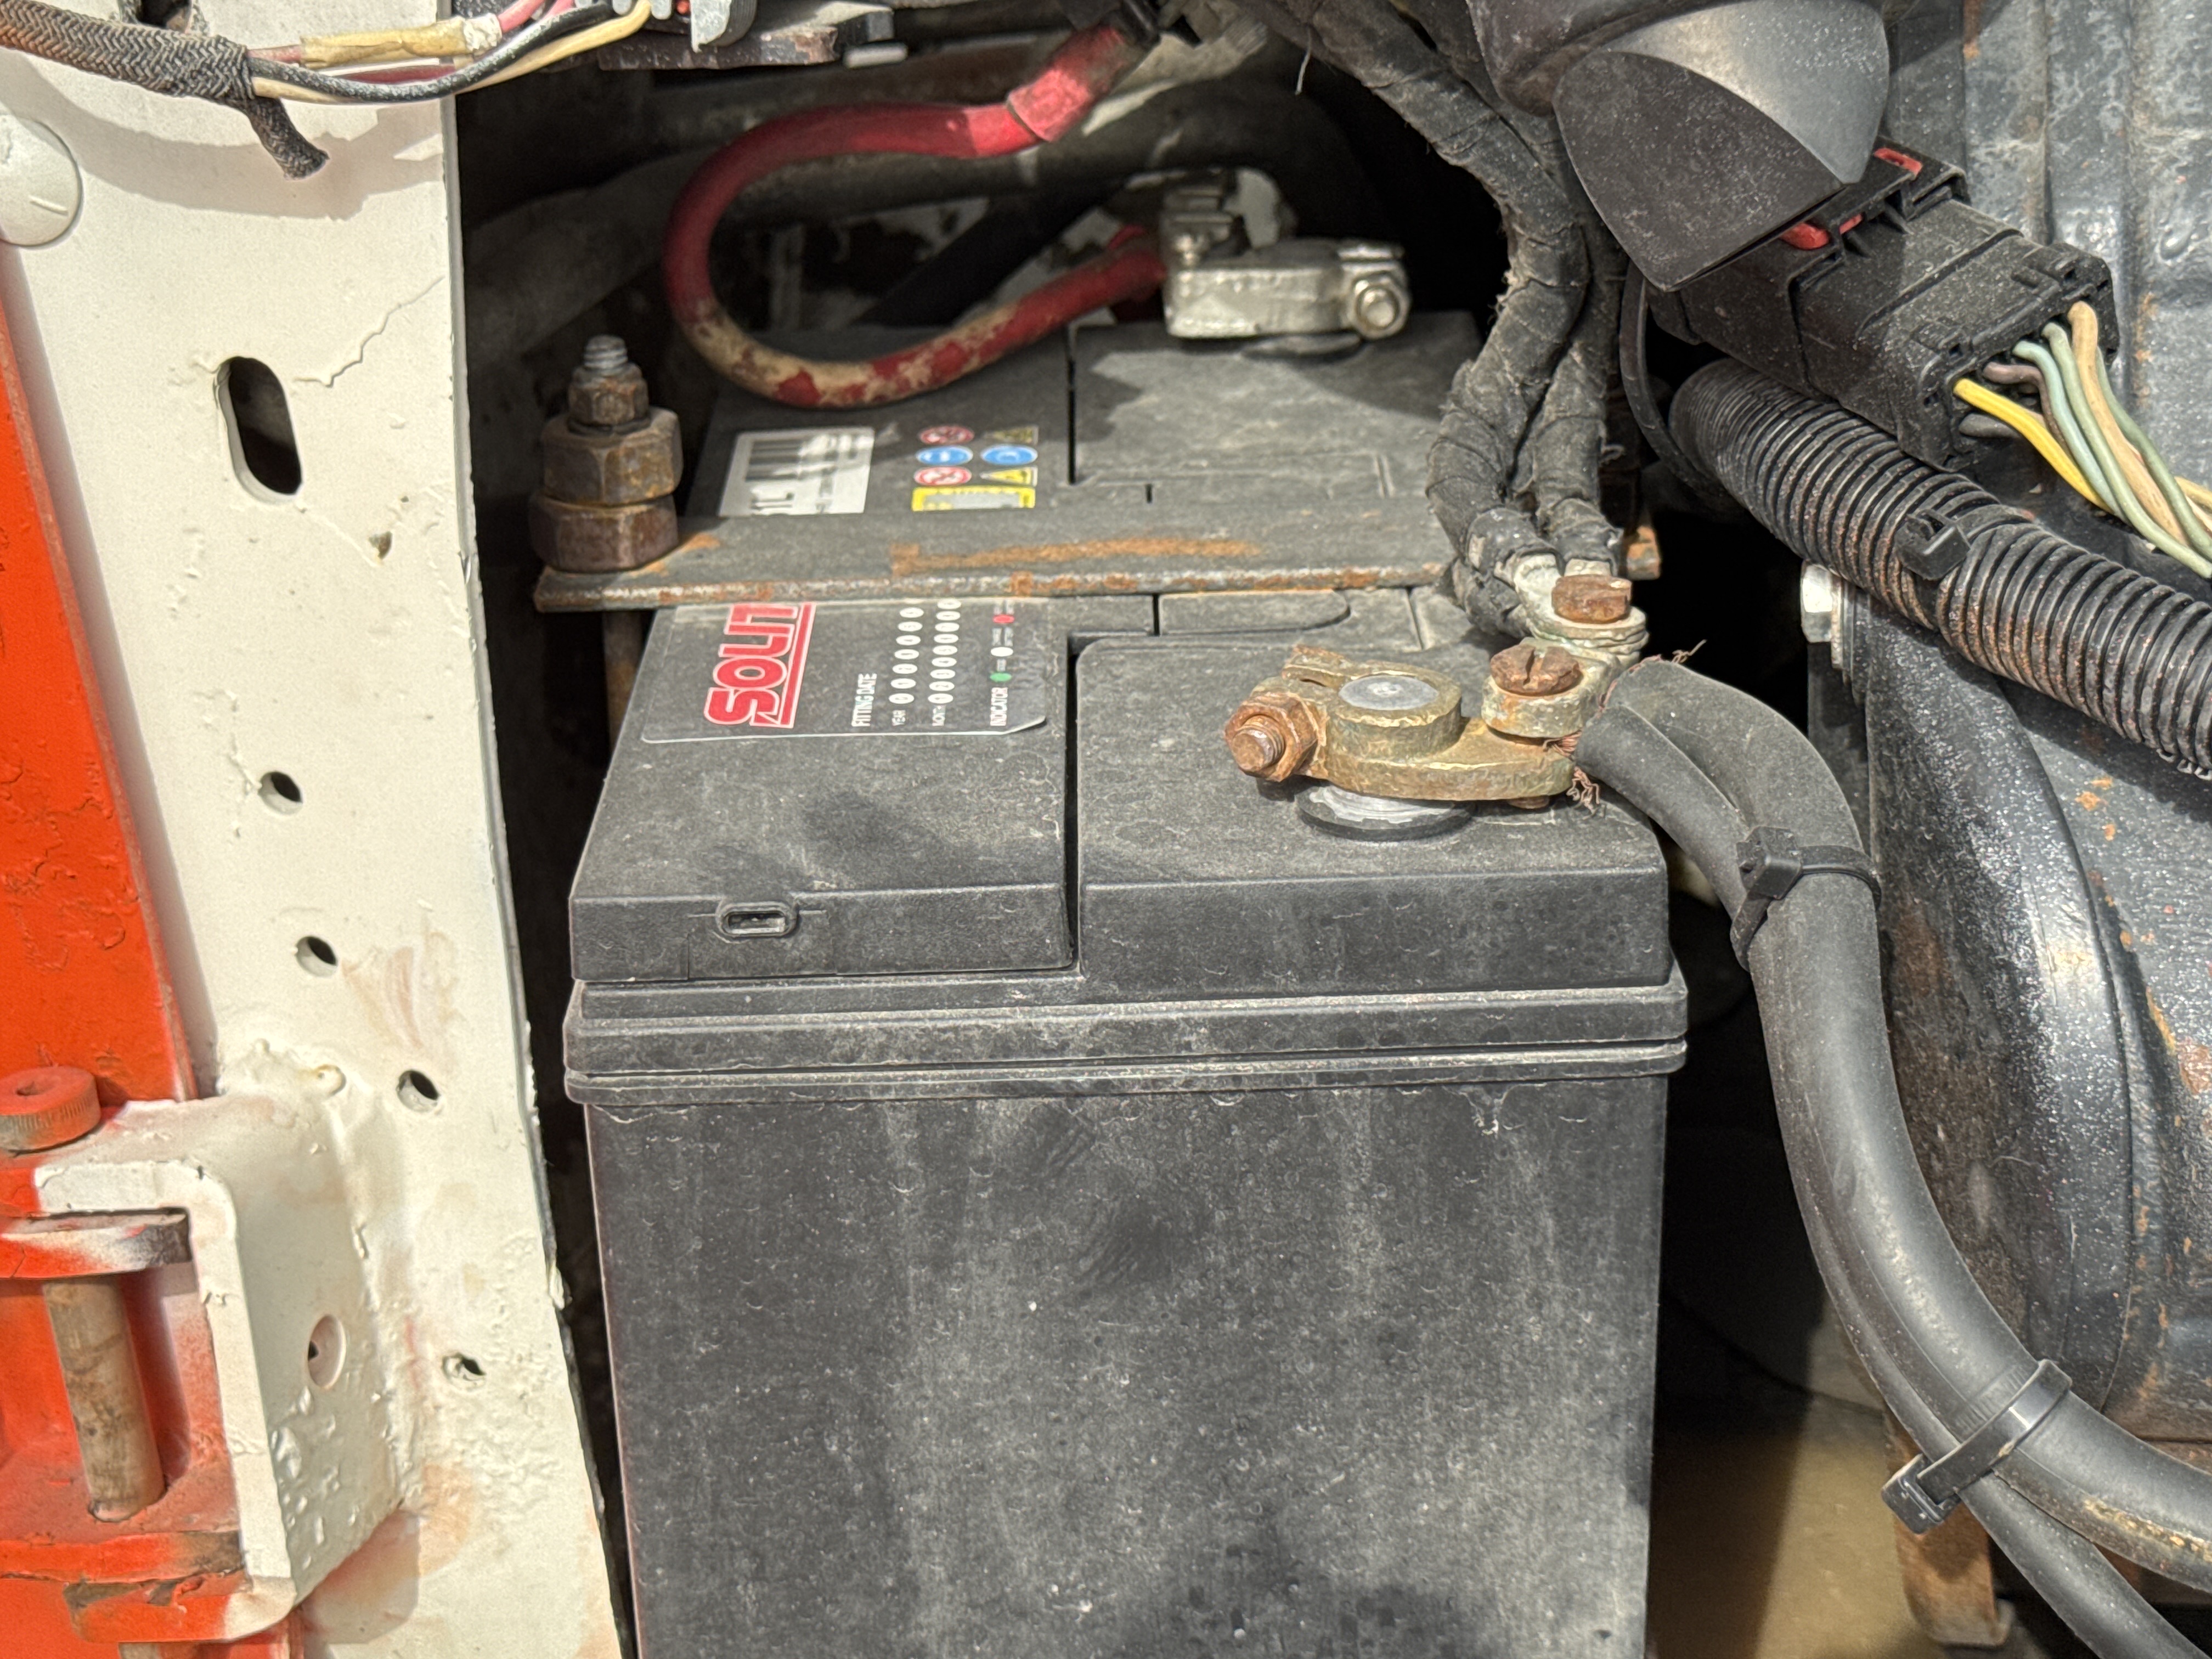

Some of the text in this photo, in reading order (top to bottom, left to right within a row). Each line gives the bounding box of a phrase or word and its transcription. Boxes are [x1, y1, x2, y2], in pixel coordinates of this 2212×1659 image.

[851, 673, 877, 727] FITTING DATE
[891, 709, 906, 726] YEAR
[990, 687, 1008, 726] INDICATOR
